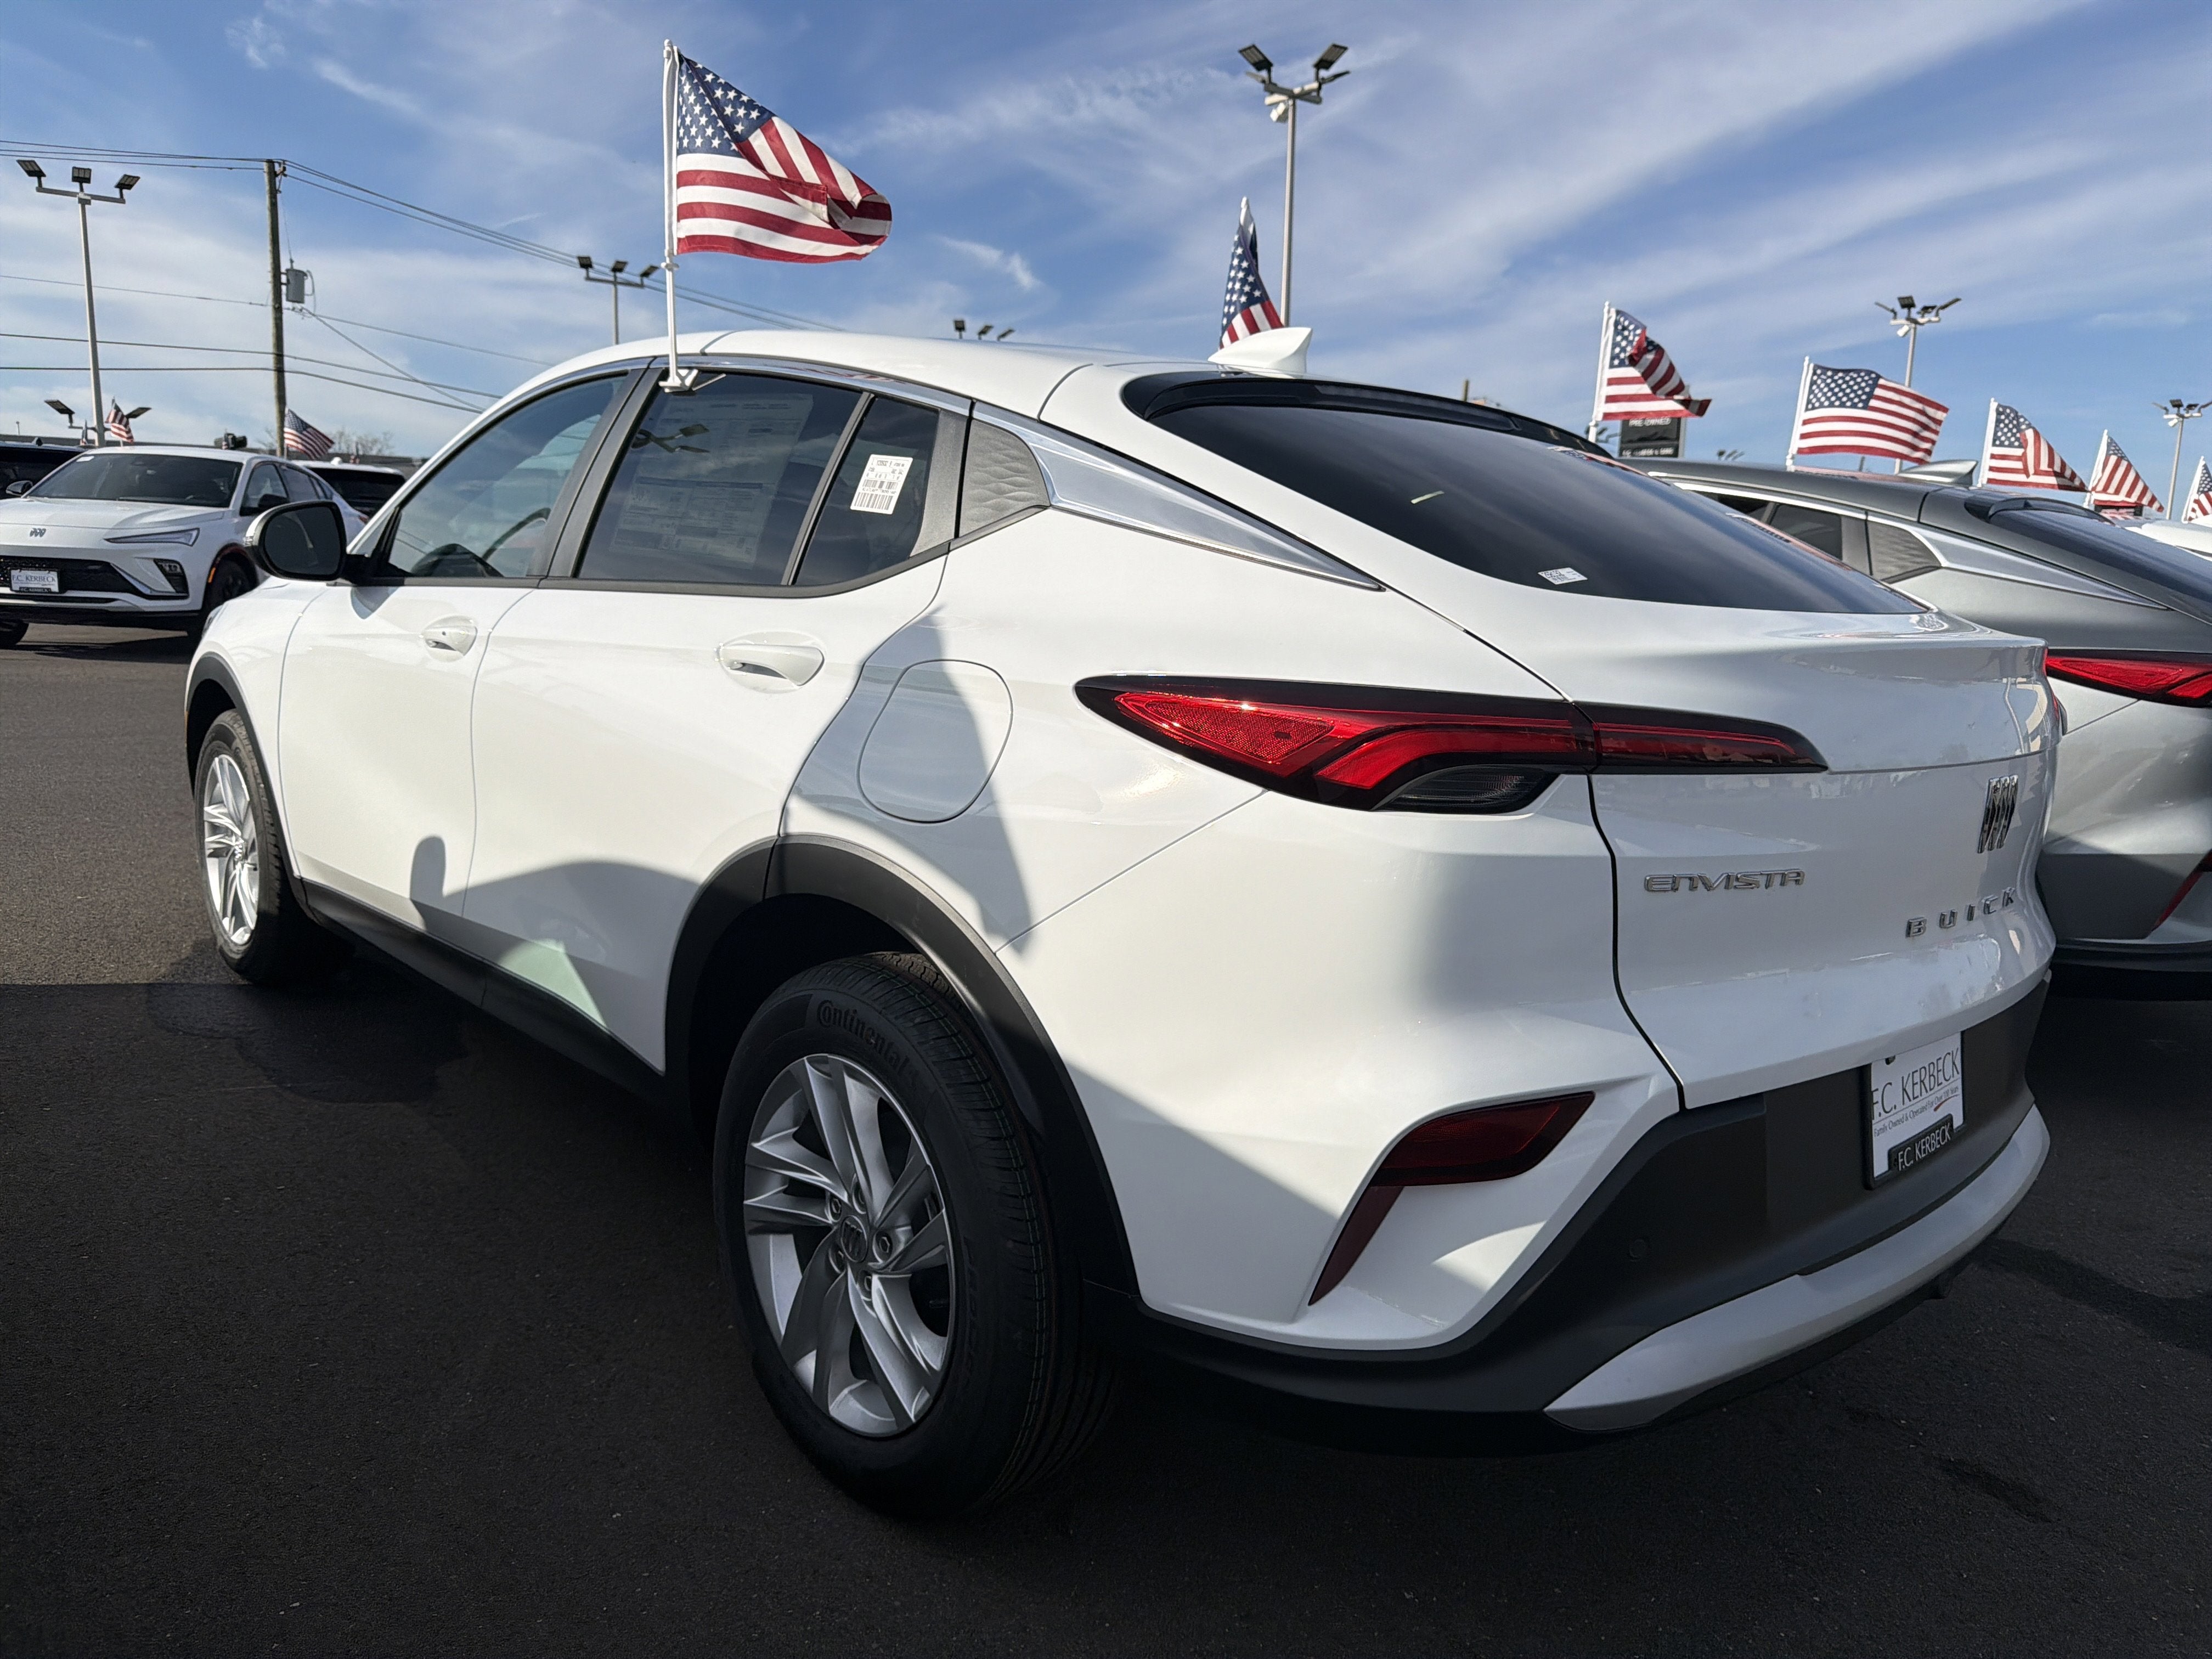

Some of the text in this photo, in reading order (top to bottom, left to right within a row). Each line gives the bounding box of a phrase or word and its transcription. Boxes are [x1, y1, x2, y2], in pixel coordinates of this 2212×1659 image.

[1644, 868, 1805, 892] ENVISTA
[1905, 886, 2016, 938] BUICK
[817, 999, 910, 1075] Continental
[1901, 1047, 1960, 1106] KERBECK
[1898, 1122, 1951, 1171] F.C. KERBECK
